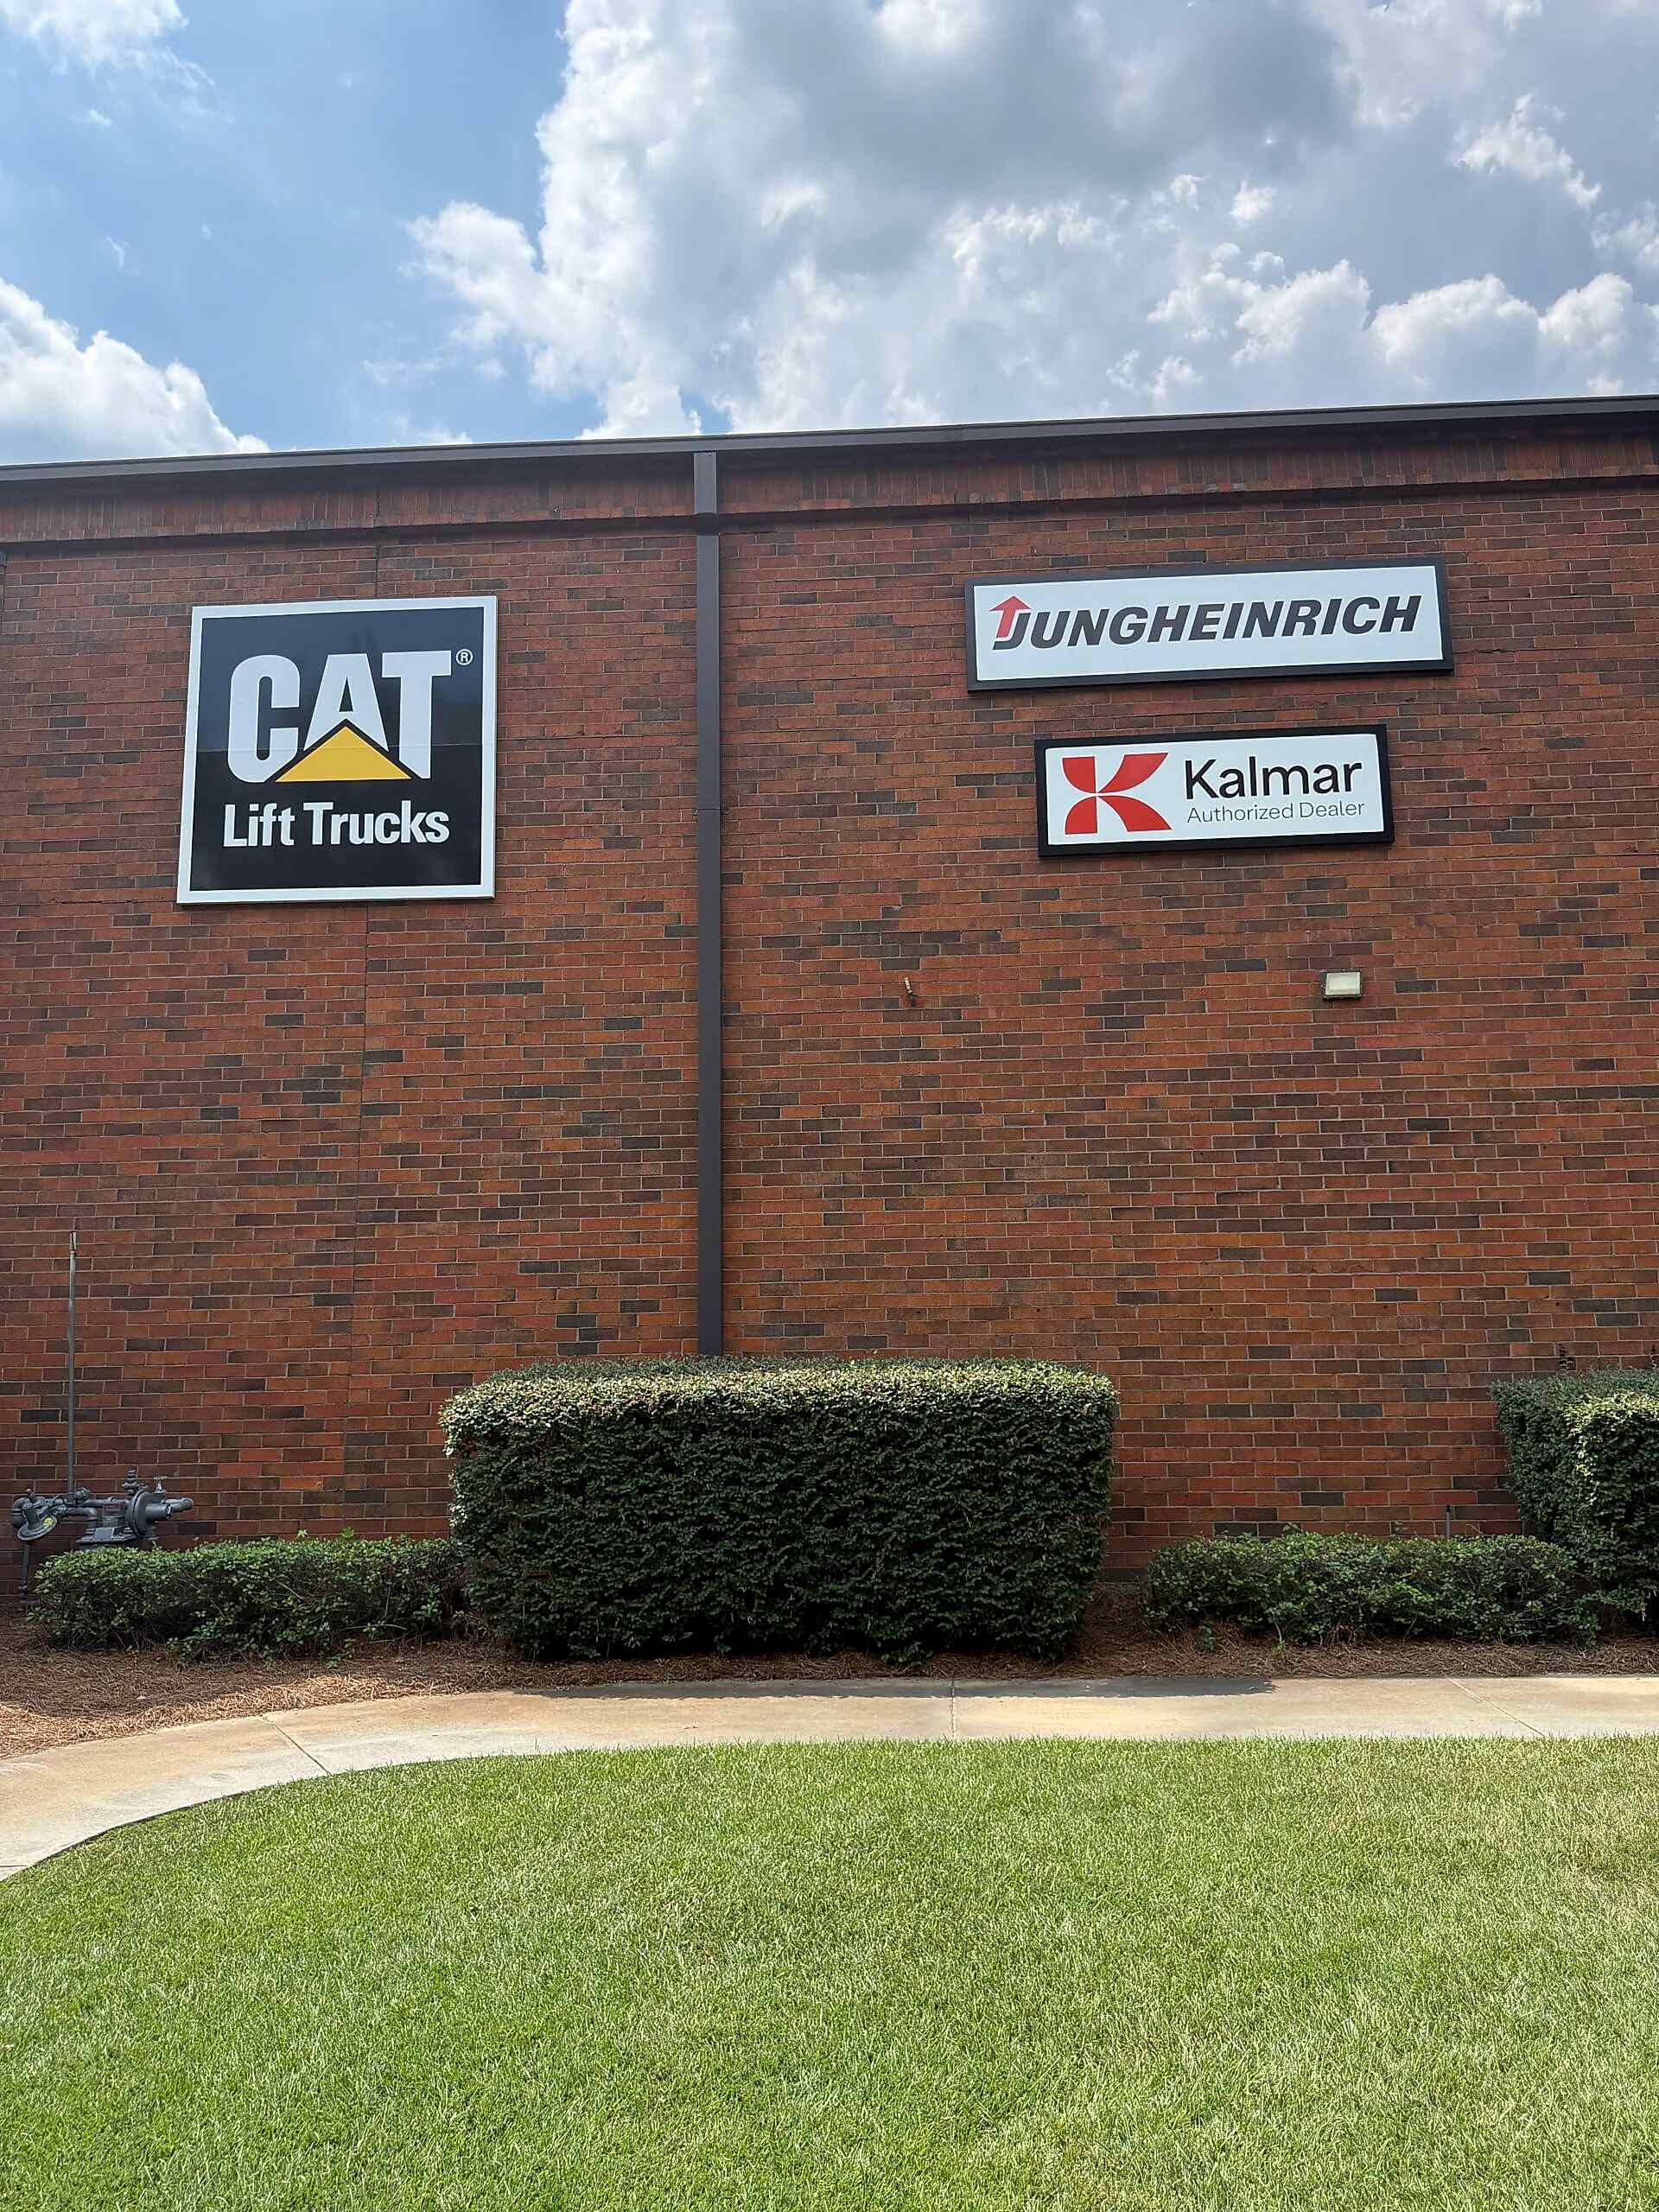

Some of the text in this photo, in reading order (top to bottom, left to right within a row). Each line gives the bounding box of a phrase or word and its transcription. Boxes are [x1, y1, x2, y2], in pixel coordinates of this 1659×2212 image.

[992, 595, 1421, 650] JUNGHEINRICH
[1184, 756, 1362, 799] Kalmar
[223, 800, 449, 848] Lift Trucks
[1186, 800, 1364, 823] Authorized Dealer
